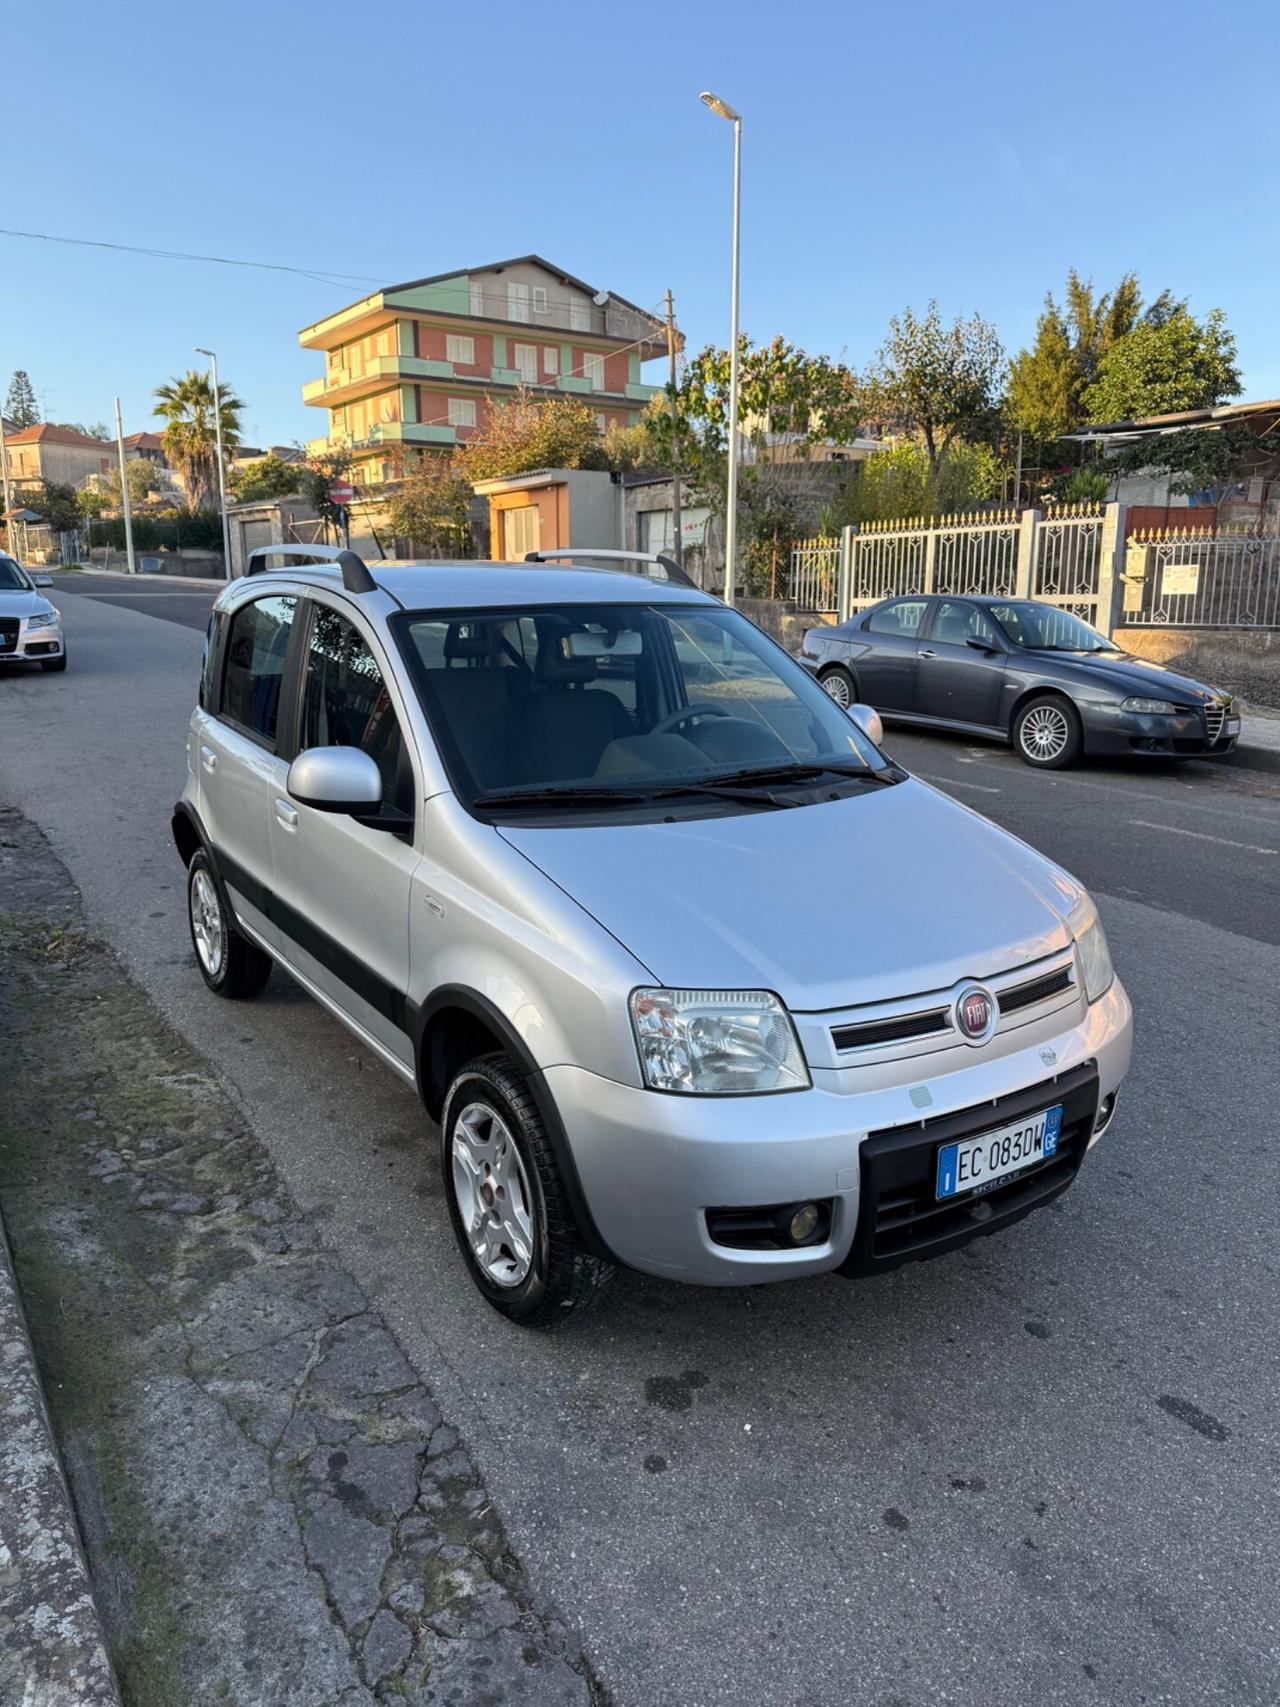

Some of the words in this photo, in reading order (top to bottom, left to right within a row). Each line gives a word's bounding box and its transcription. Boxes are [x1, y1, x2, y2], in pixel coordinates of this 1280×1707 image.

[966, 1002, 986, 1026] FIAT
[958, 1147, 982, 1182] EC
[989, 1122, 1045, 1171] 083DW
[1045, 1131, 1057, 1150] GE
